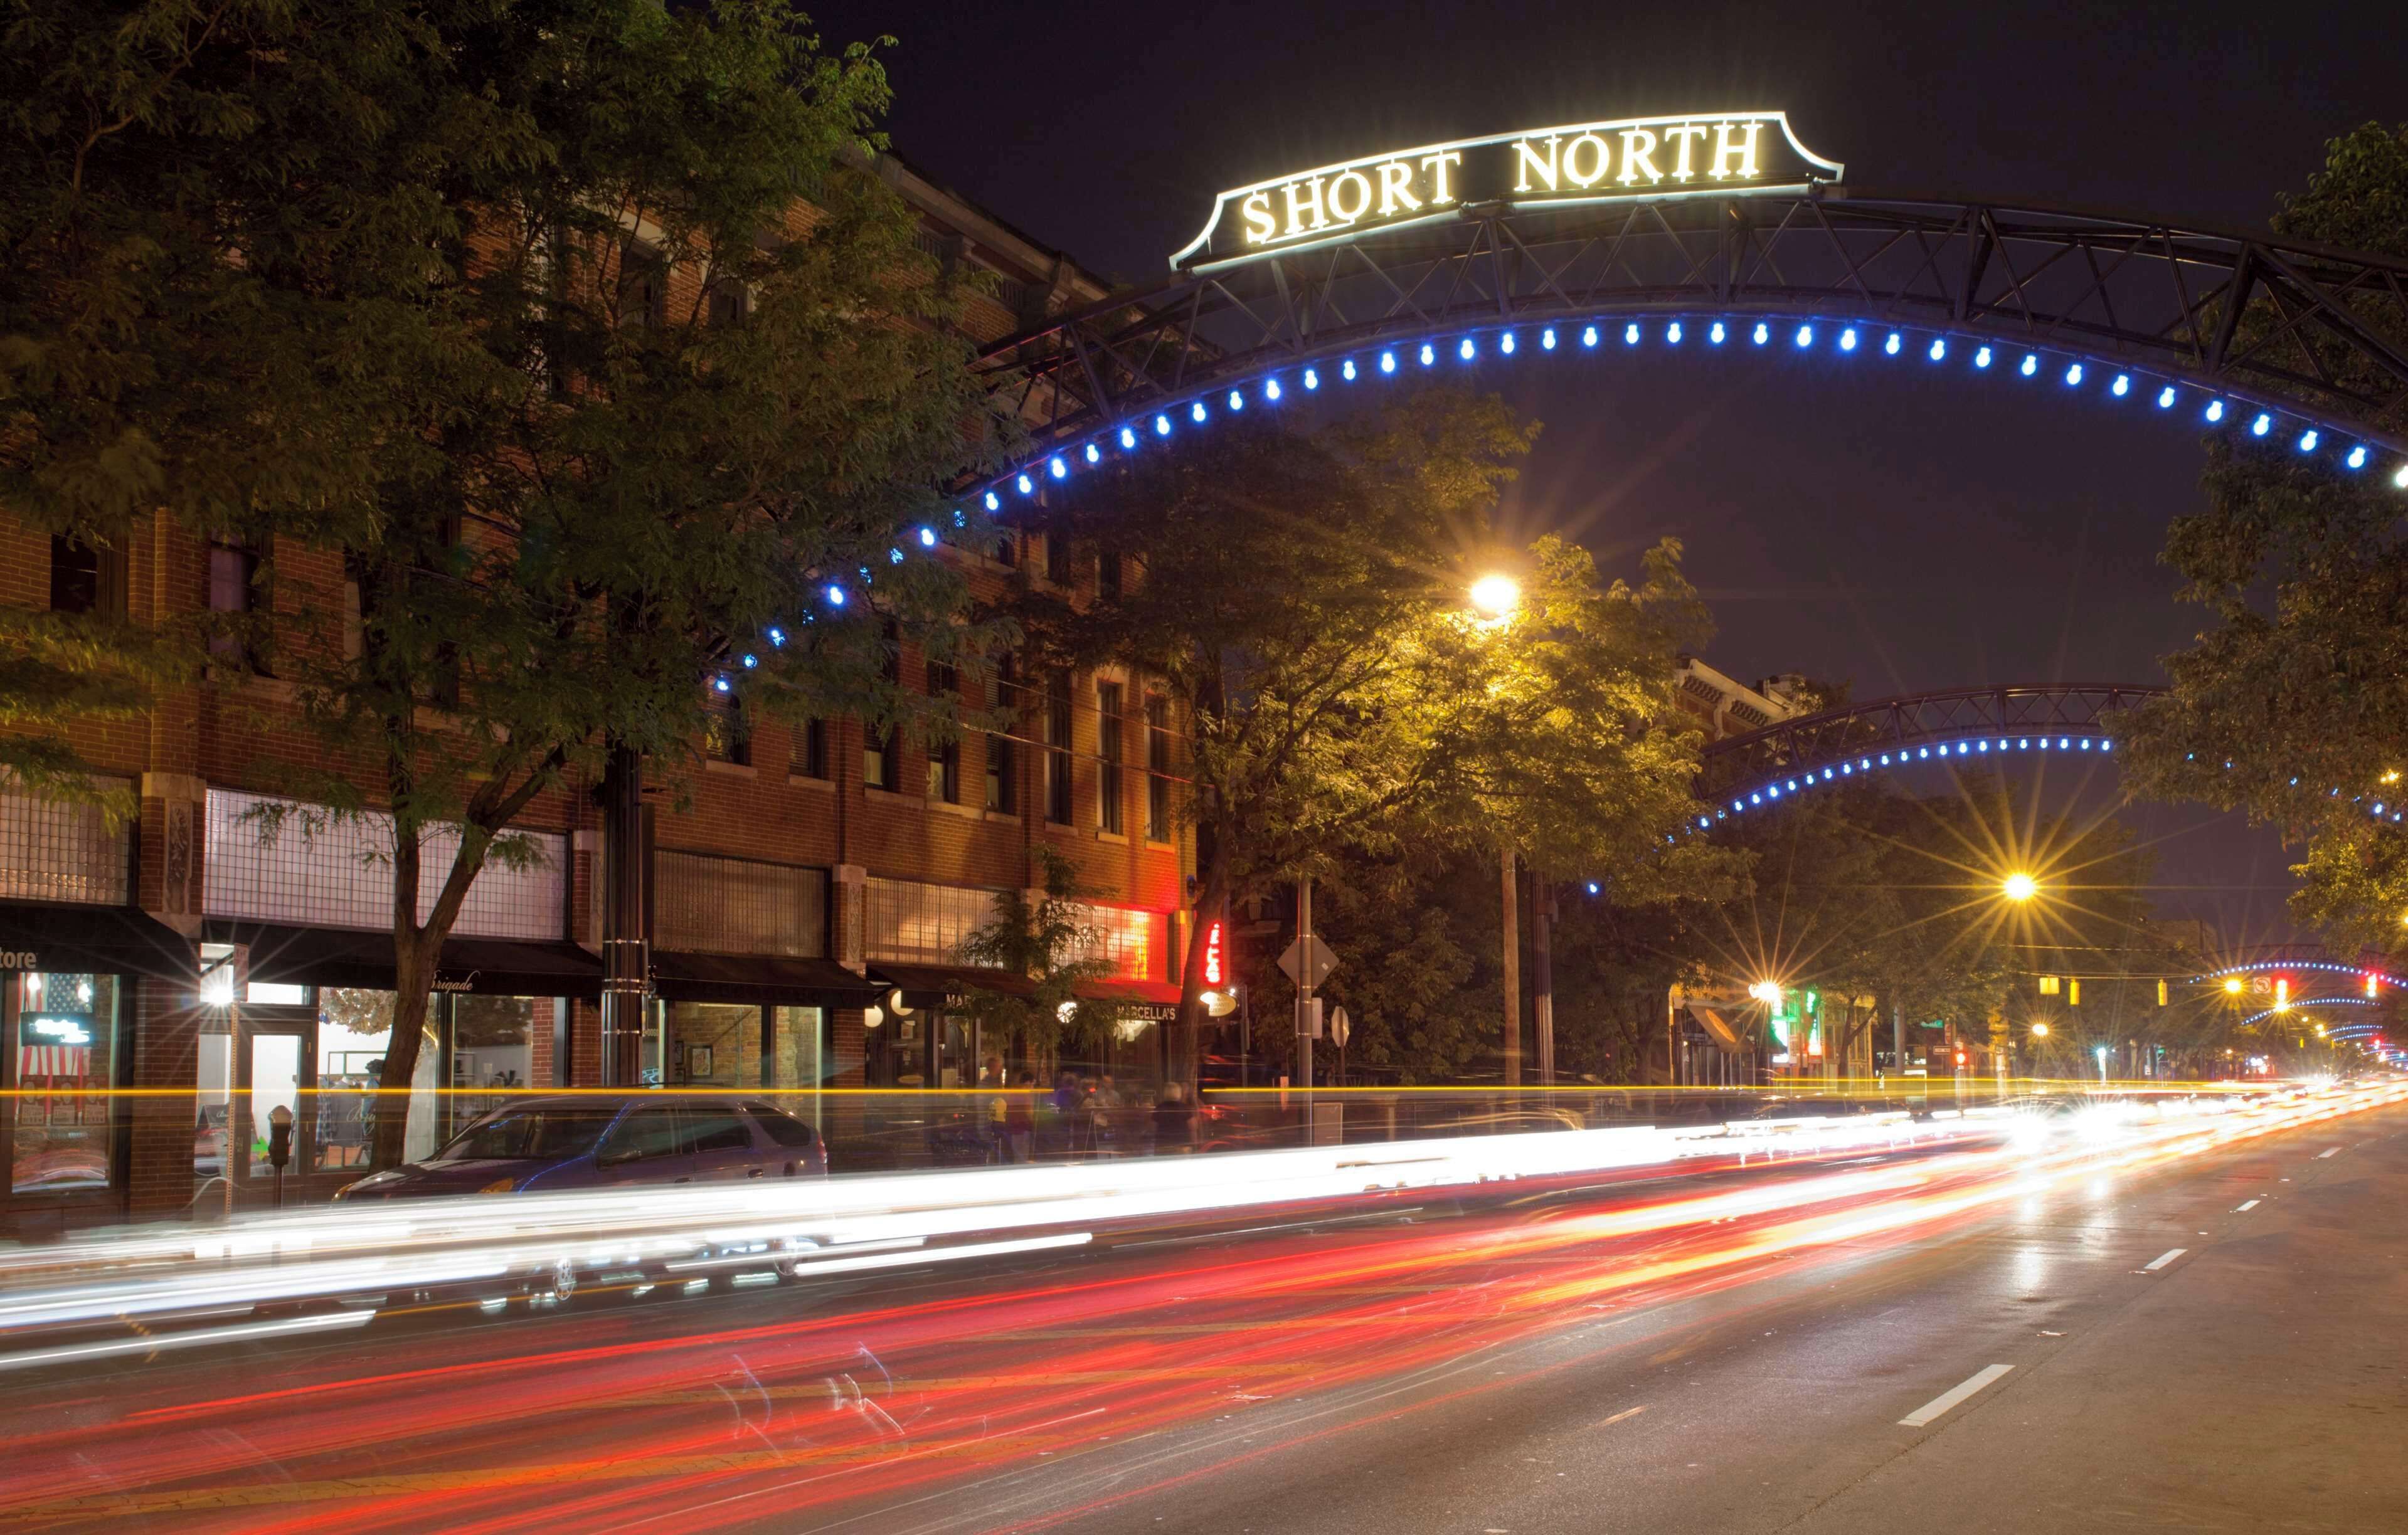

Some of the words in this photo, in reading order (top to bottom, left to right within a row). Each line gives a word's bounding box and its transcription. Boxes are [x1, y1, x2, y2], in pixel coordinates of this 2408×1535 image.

[1242, 150, 1461, 243] SHORT
[1512, 124, 1764, 191] NORTH
[1116, 1006, 1176, 1020] MRCELLA'S
